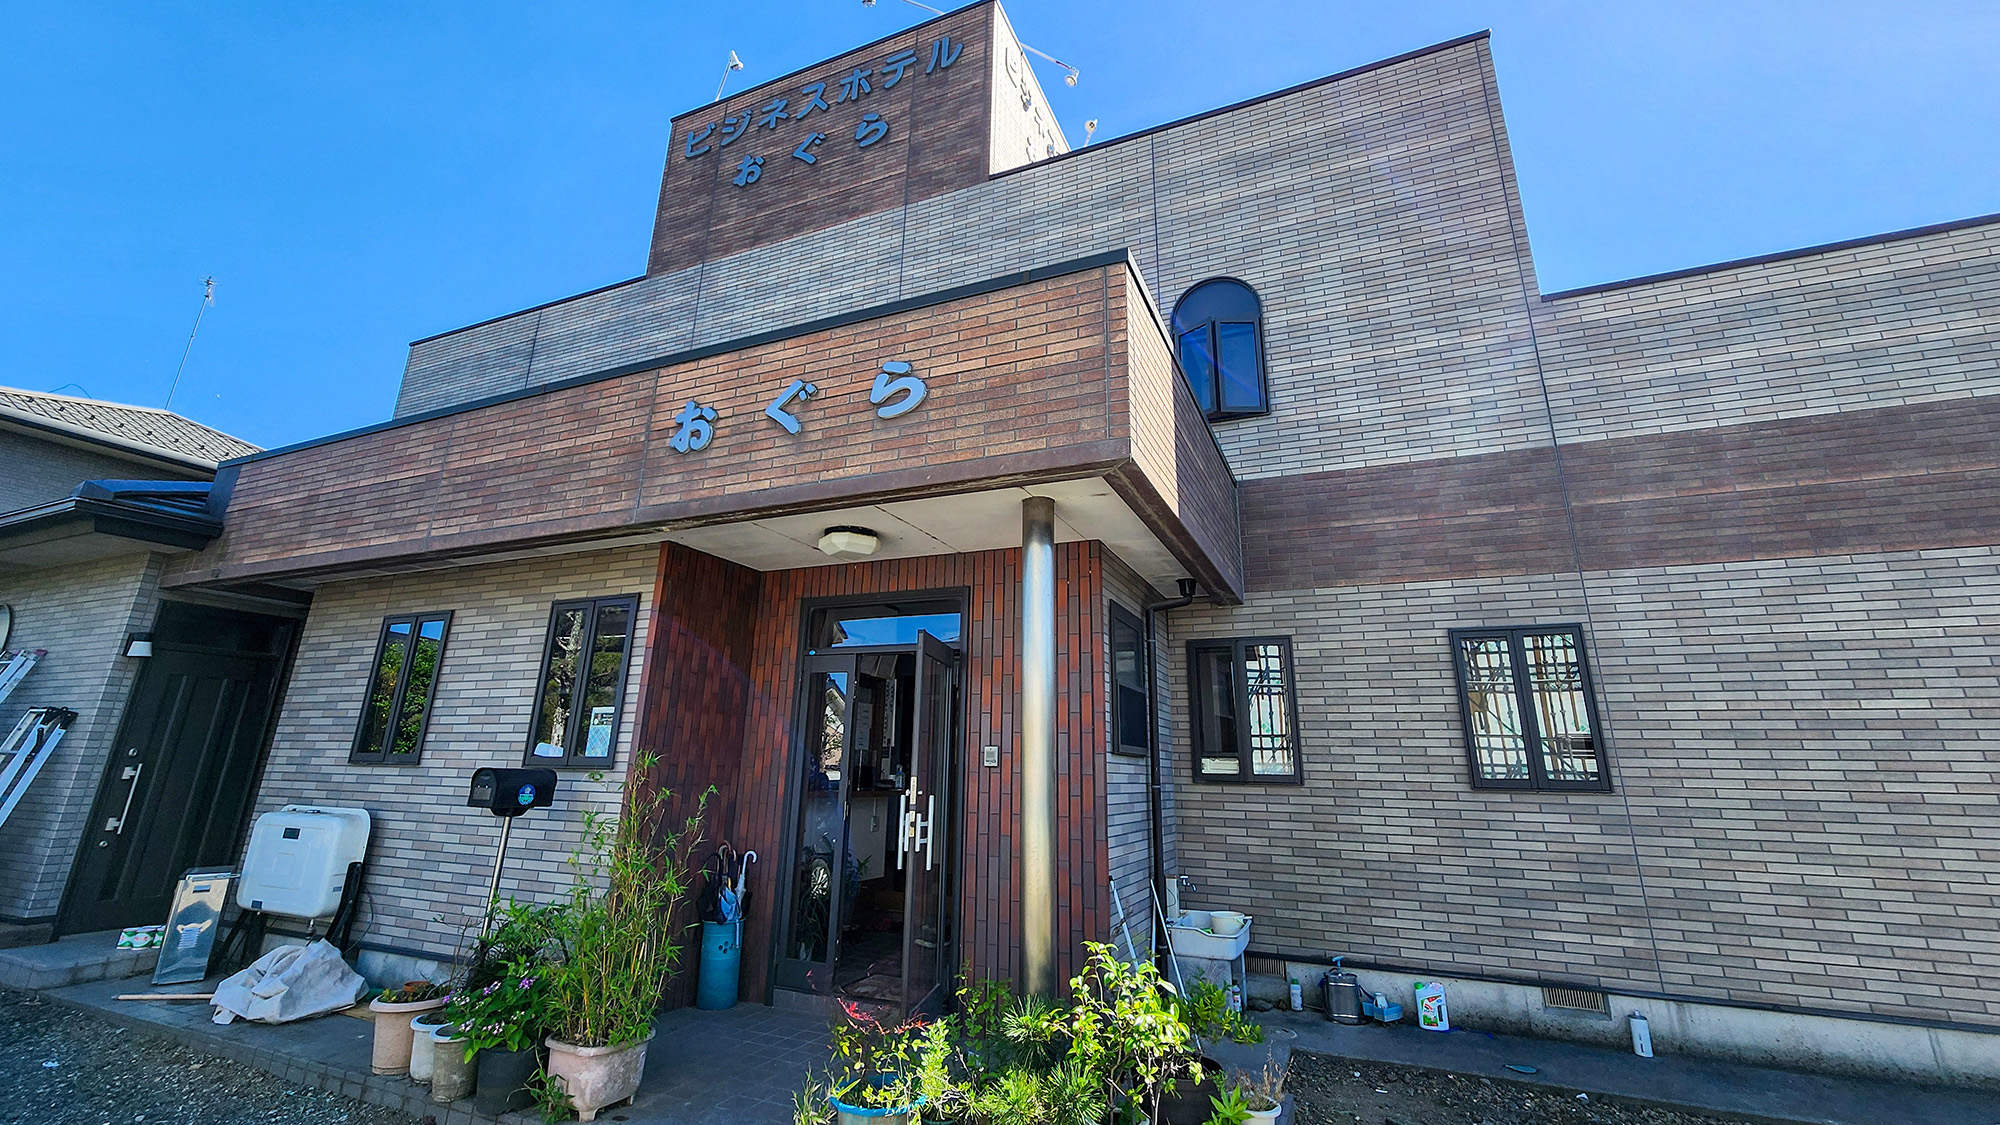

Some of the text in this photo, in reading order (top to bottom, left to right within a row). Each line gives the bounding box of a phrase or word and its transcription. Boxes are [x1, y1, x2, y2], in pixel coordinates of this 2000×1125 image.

[684, 36, 964, 158] ビジネスホテル
[733, 113, 889, 187] おぐら
[669, 360, 929, 454] おぐら
